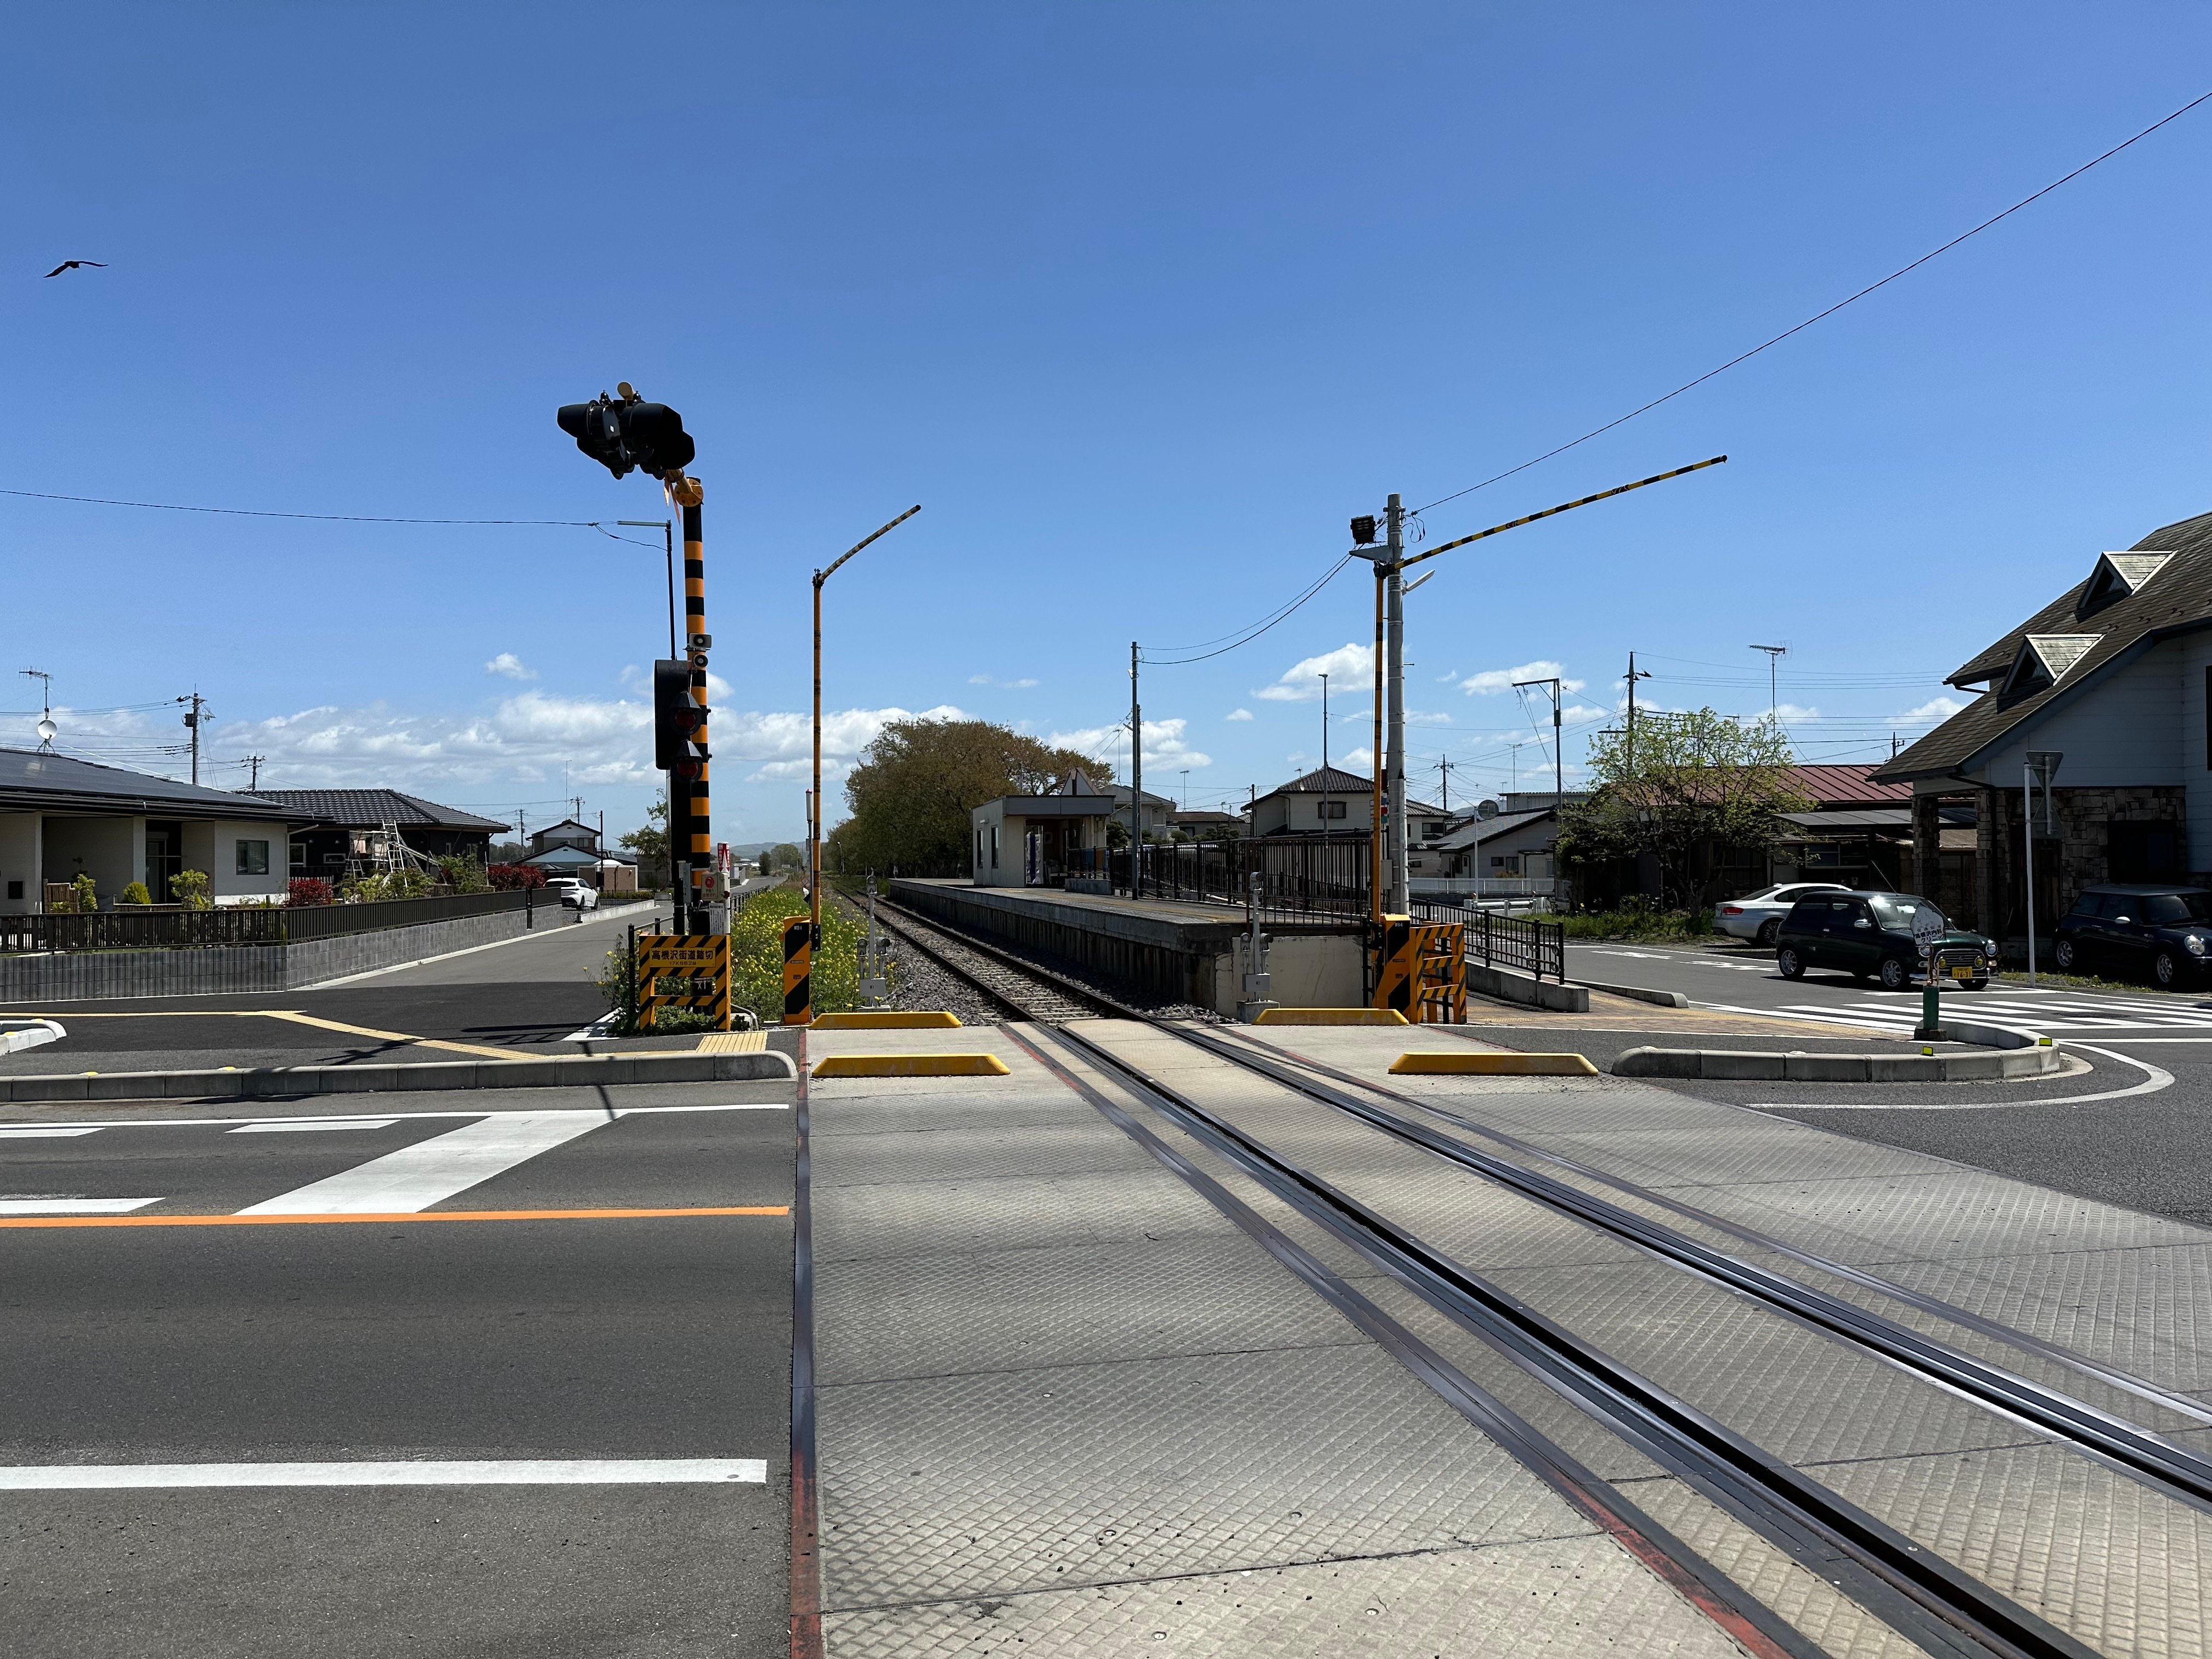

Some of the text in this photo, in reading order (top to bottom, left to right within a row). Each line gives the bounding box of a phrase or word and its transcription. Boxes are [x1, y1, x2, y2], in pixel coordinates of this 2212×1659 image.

[652, 950, 713, 960] 高根沢街道踏切
